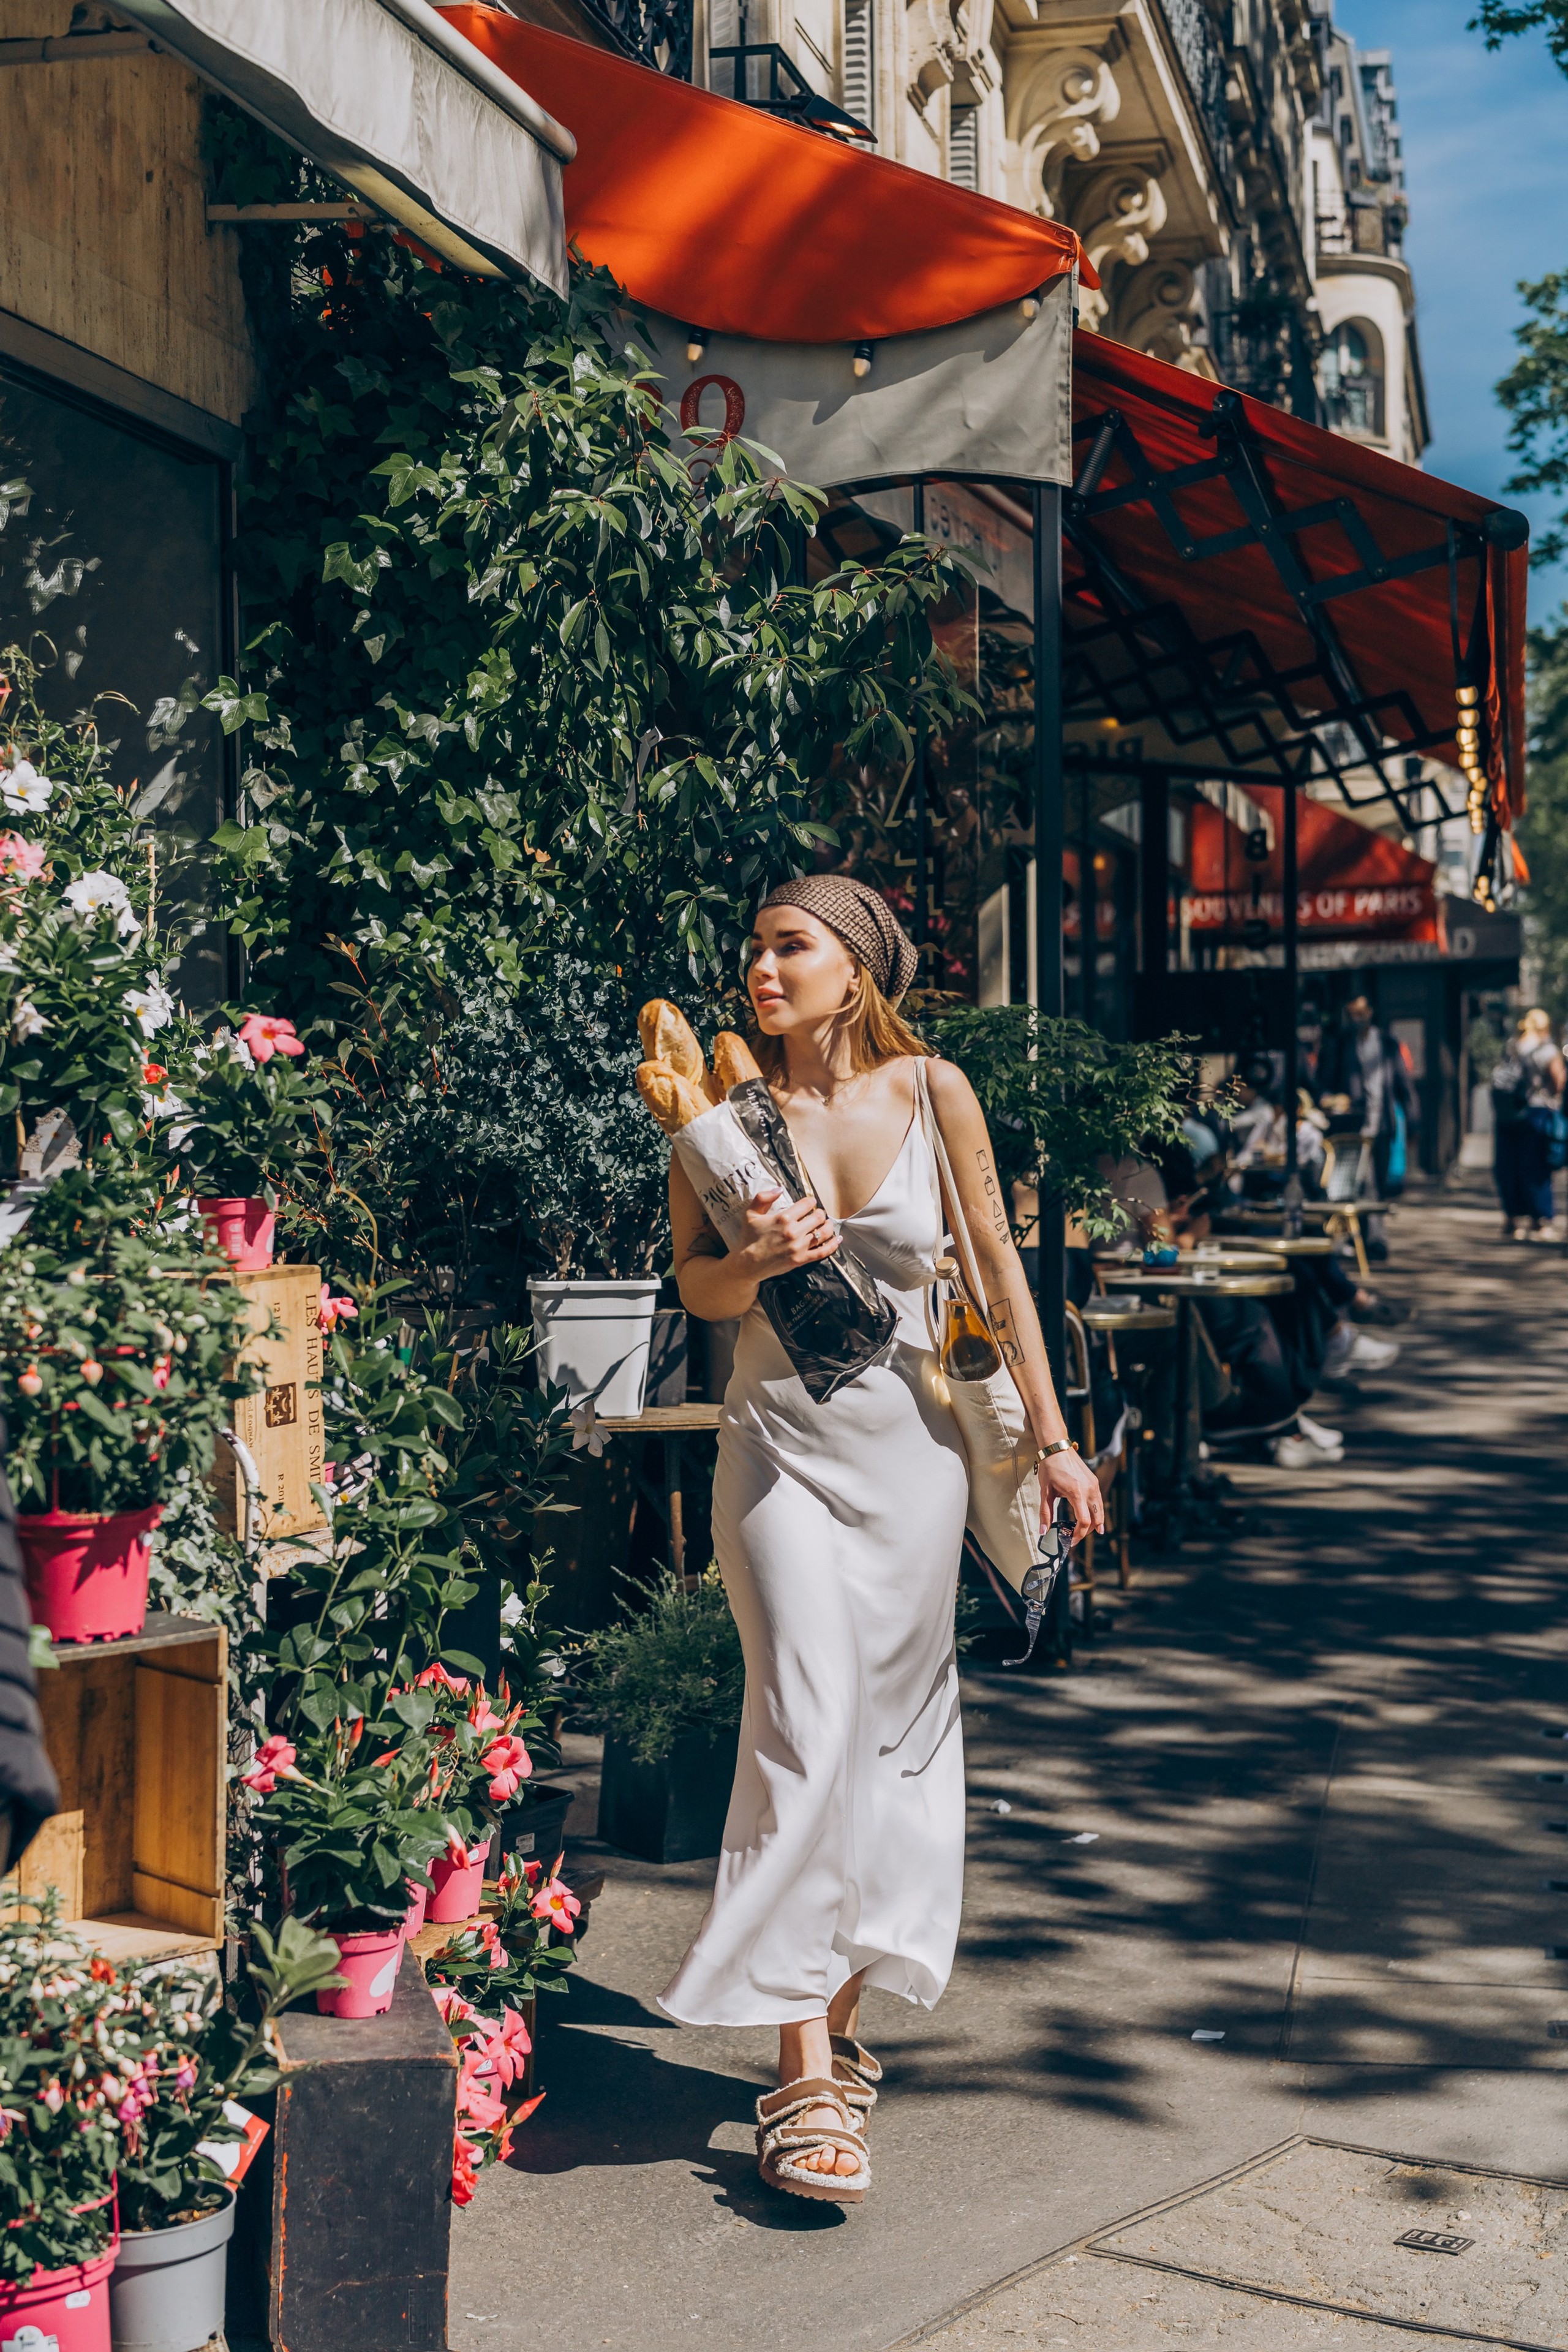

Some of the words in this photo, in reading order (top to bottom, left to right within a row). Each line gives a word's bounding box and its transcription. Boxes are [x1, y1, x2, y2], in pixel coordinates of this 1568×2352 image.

[1316, 889, 1350, 919] OF
[1354, 886, 1423, 916] PARIS
[273, 1302, 281, 1313] 12
[306, 1294, 317, 1327] LES
[308, 1409, 320, 1436] DE
[309, 1445, 322, 1504] SMI
